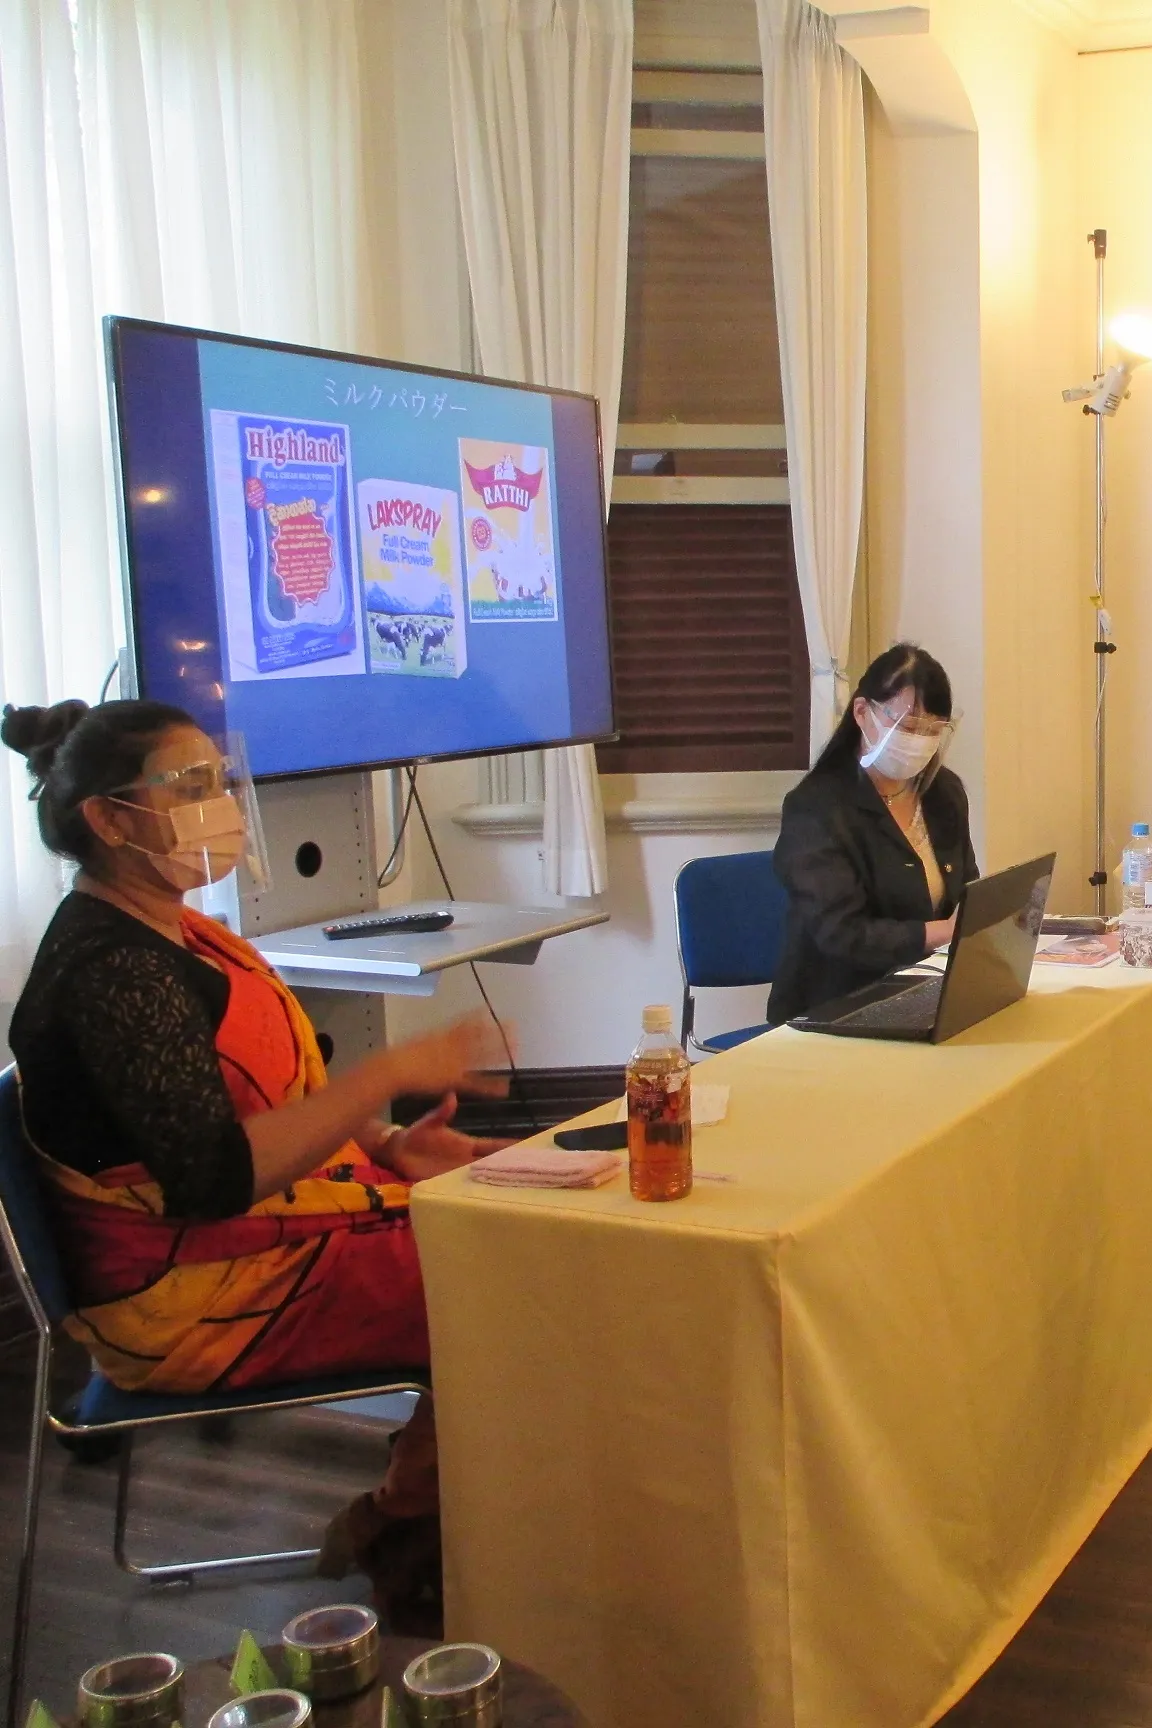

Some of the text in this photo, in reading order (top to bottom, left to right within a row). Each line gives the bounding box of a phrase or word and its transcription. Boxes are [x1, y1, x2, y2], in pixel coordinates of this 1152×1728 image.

[322, 377, 468, 420] ミルクパウダー
[246, 427, 342, 467] Highland
[483, 484, 529, 508] RATTHI
[367, 498, 442, 538] LAKSPRAY
[380, 548, 434, 567] Milk Powder
[383, 534, 430, 552] Full Cream
